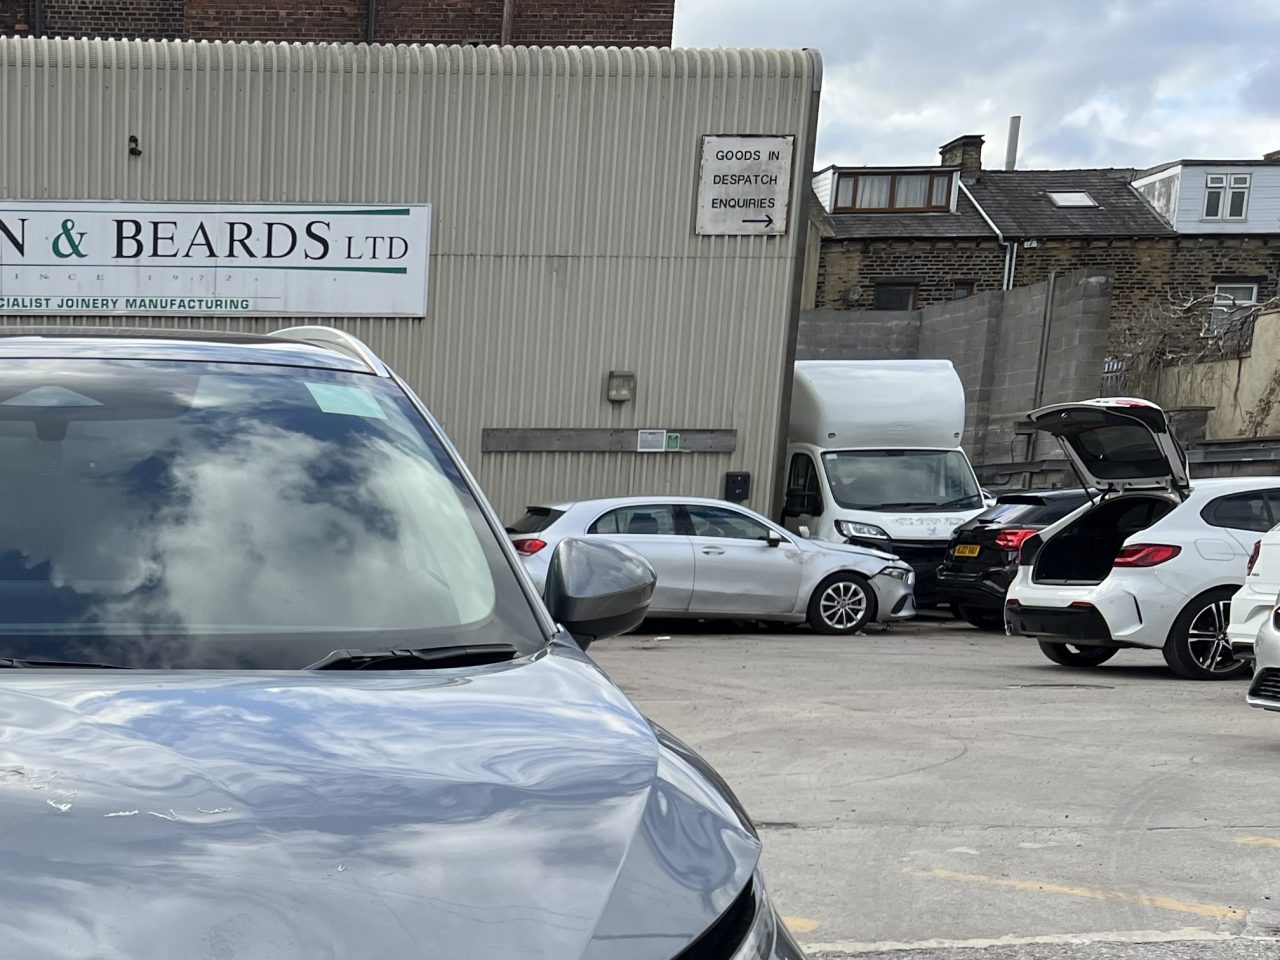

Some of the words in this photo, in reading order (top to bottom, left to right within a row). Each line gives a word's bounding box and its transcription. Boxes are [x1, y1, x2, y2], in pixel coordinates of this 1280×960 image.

[715, 150, 761, 161] GOODS
[768, 150, 780, 161] IN
[712, 174, 778, 185] DESPATCH
[711, 197, 775, 209] ENQUIRIES
[51, 218, 88, 259] &
[111, 219, 331, 260] BEARDS
[344, 235, 409, 260] LTD
[57, 298, 119, 309] JOINERY
[125, 298, 250, 310] MANUFACTURING
